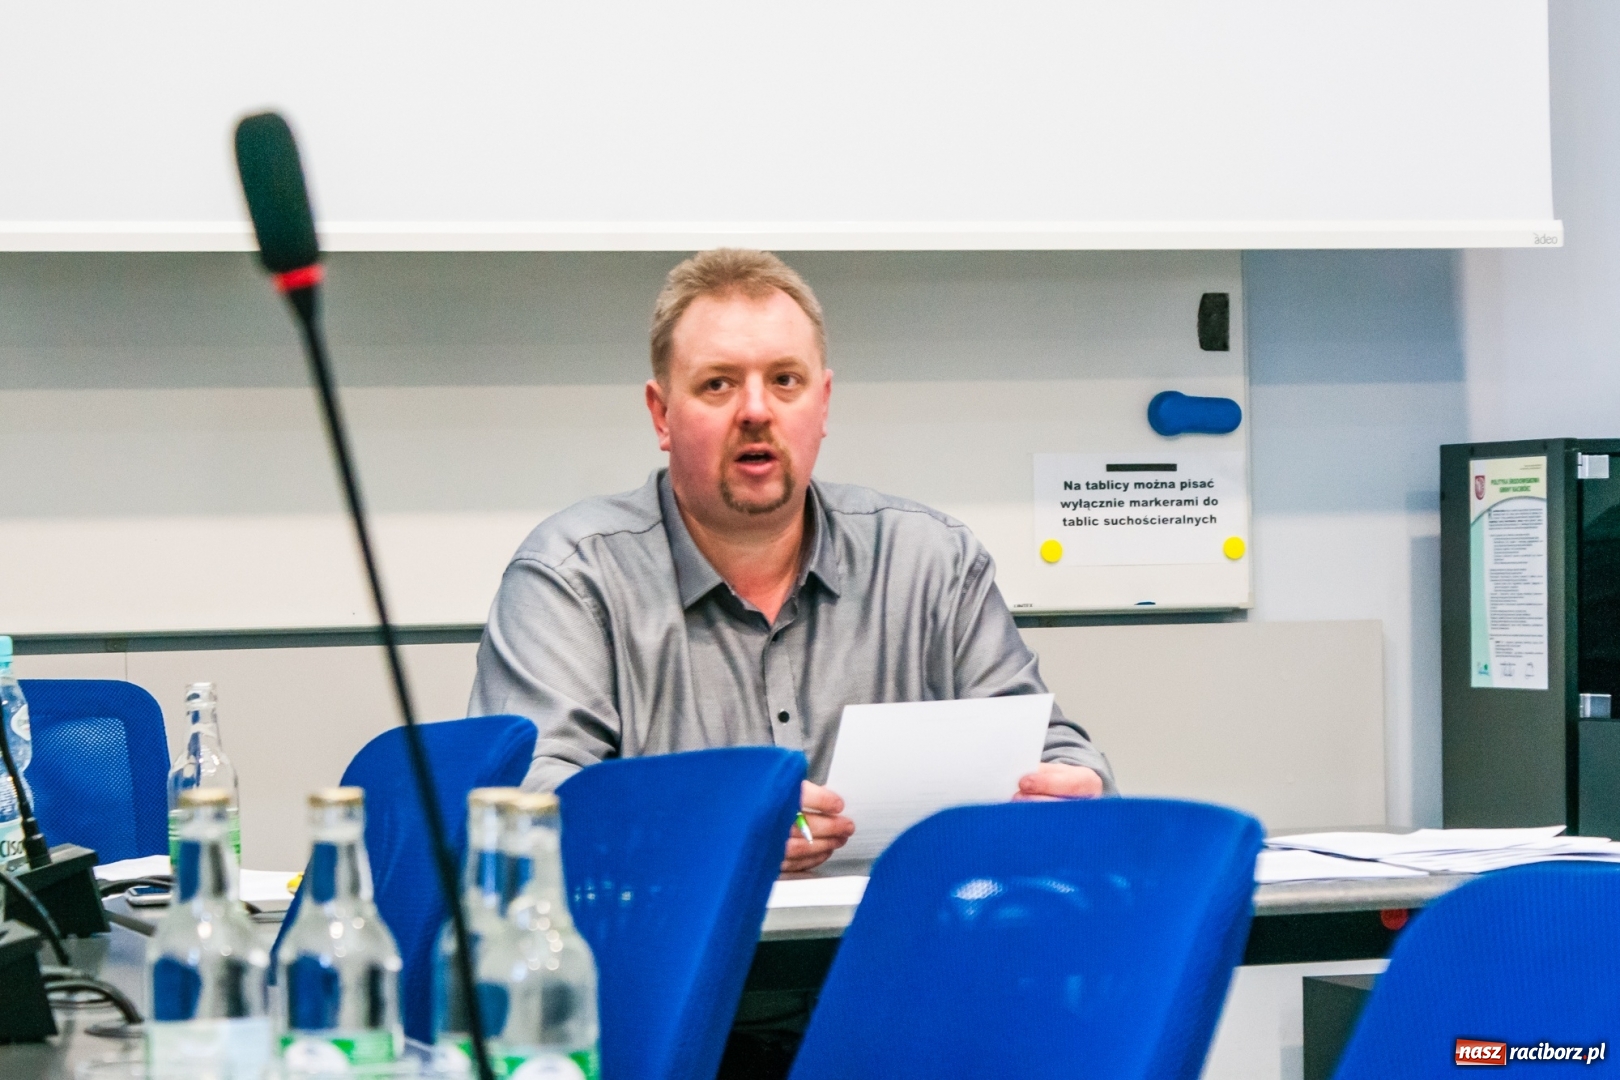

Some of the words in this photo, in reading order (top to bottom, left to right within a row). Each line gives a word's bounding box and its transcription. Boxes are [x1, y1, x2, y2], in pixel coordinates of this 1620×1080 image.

[1063, 480, 1081, 491] Na
[1085, 480, 1130, 492] tablicy
[1134, 479, 1176, 490] można
[1180, 478, 1215, 491] pisać
[1060, 498, 1125, 511] wyłącznie
[1129, 497, 1199, 508] markerami
[1203, 496, 1219, 507] do
[1062, 516, 1100, 527] tablic
[1103, 514, 1217, 527] suchościeralnych
